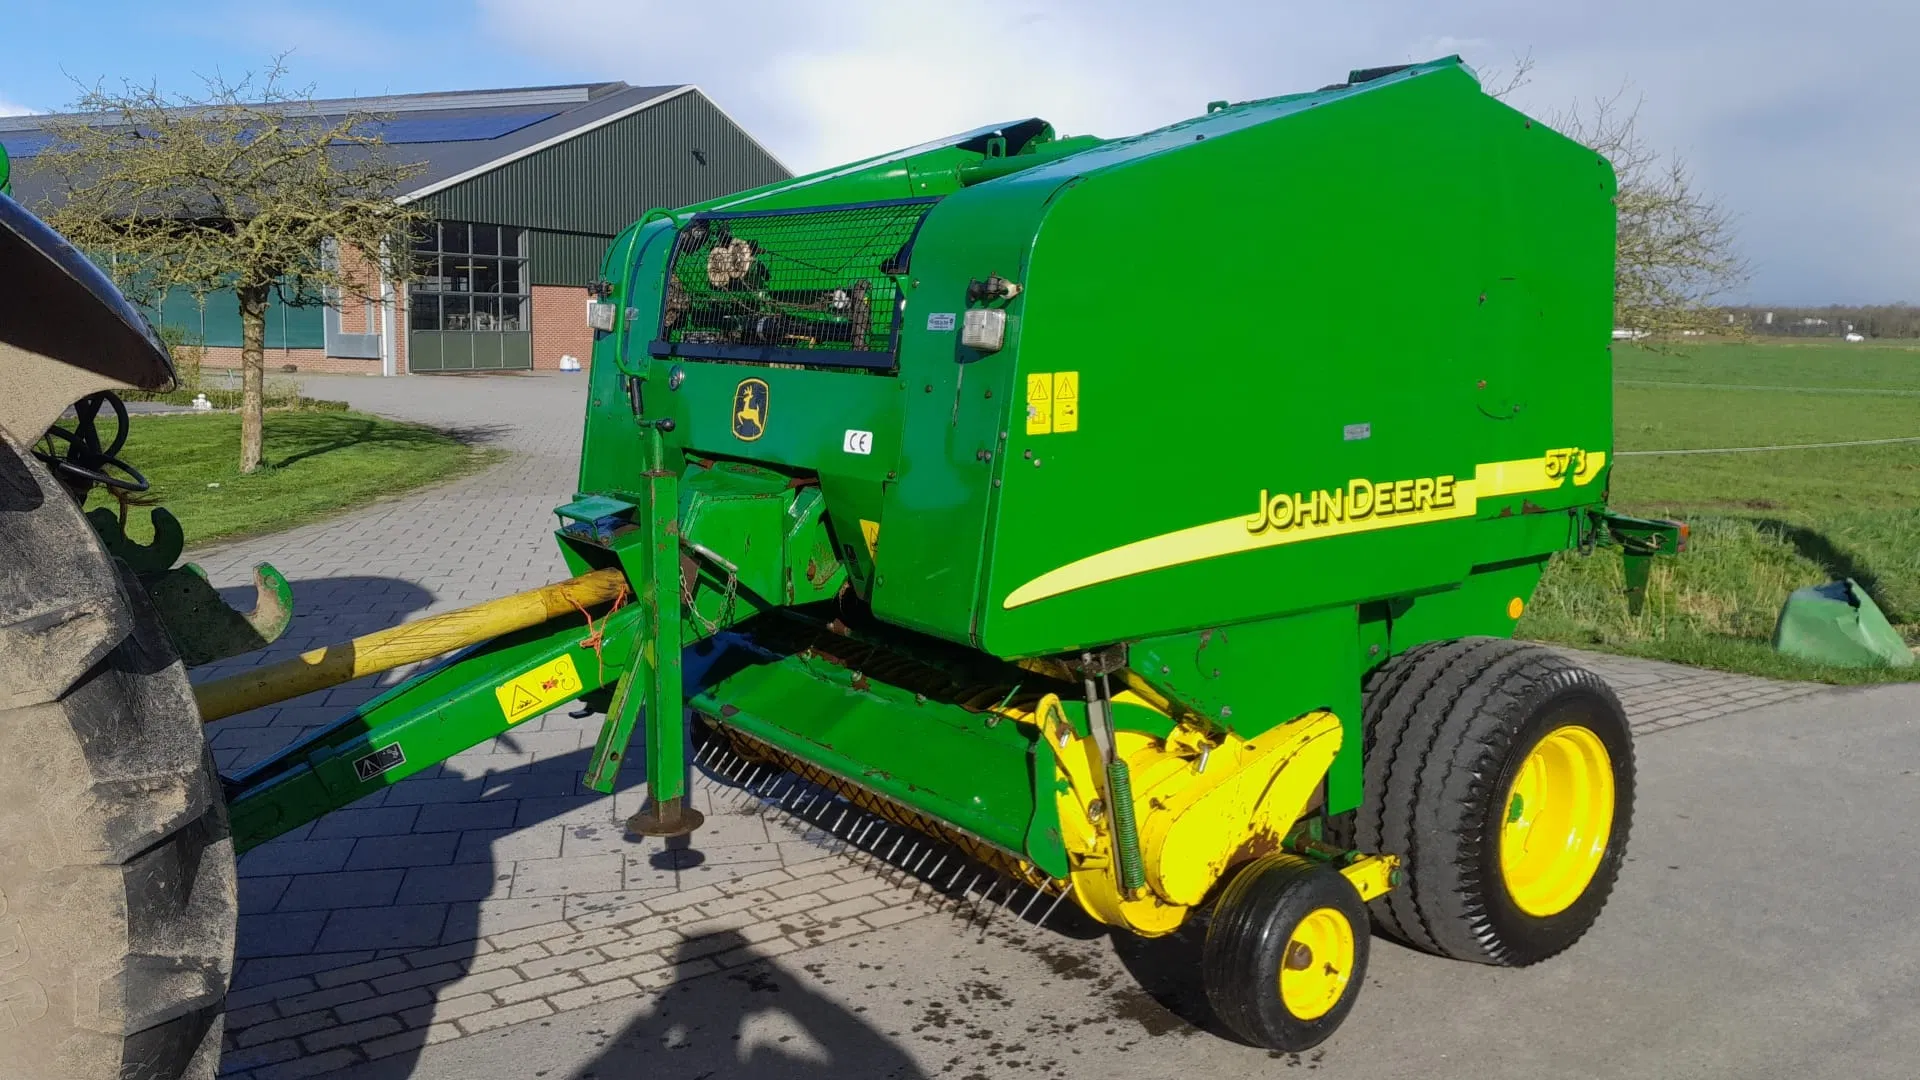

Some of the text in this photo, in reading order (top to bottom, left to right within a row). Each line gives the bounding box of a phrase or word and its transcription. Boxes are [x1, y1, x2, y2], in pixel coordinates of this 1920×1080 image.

[849, 432, 867, 452] CE
[1247, 474, 1455, 533] JOHN DEERE
